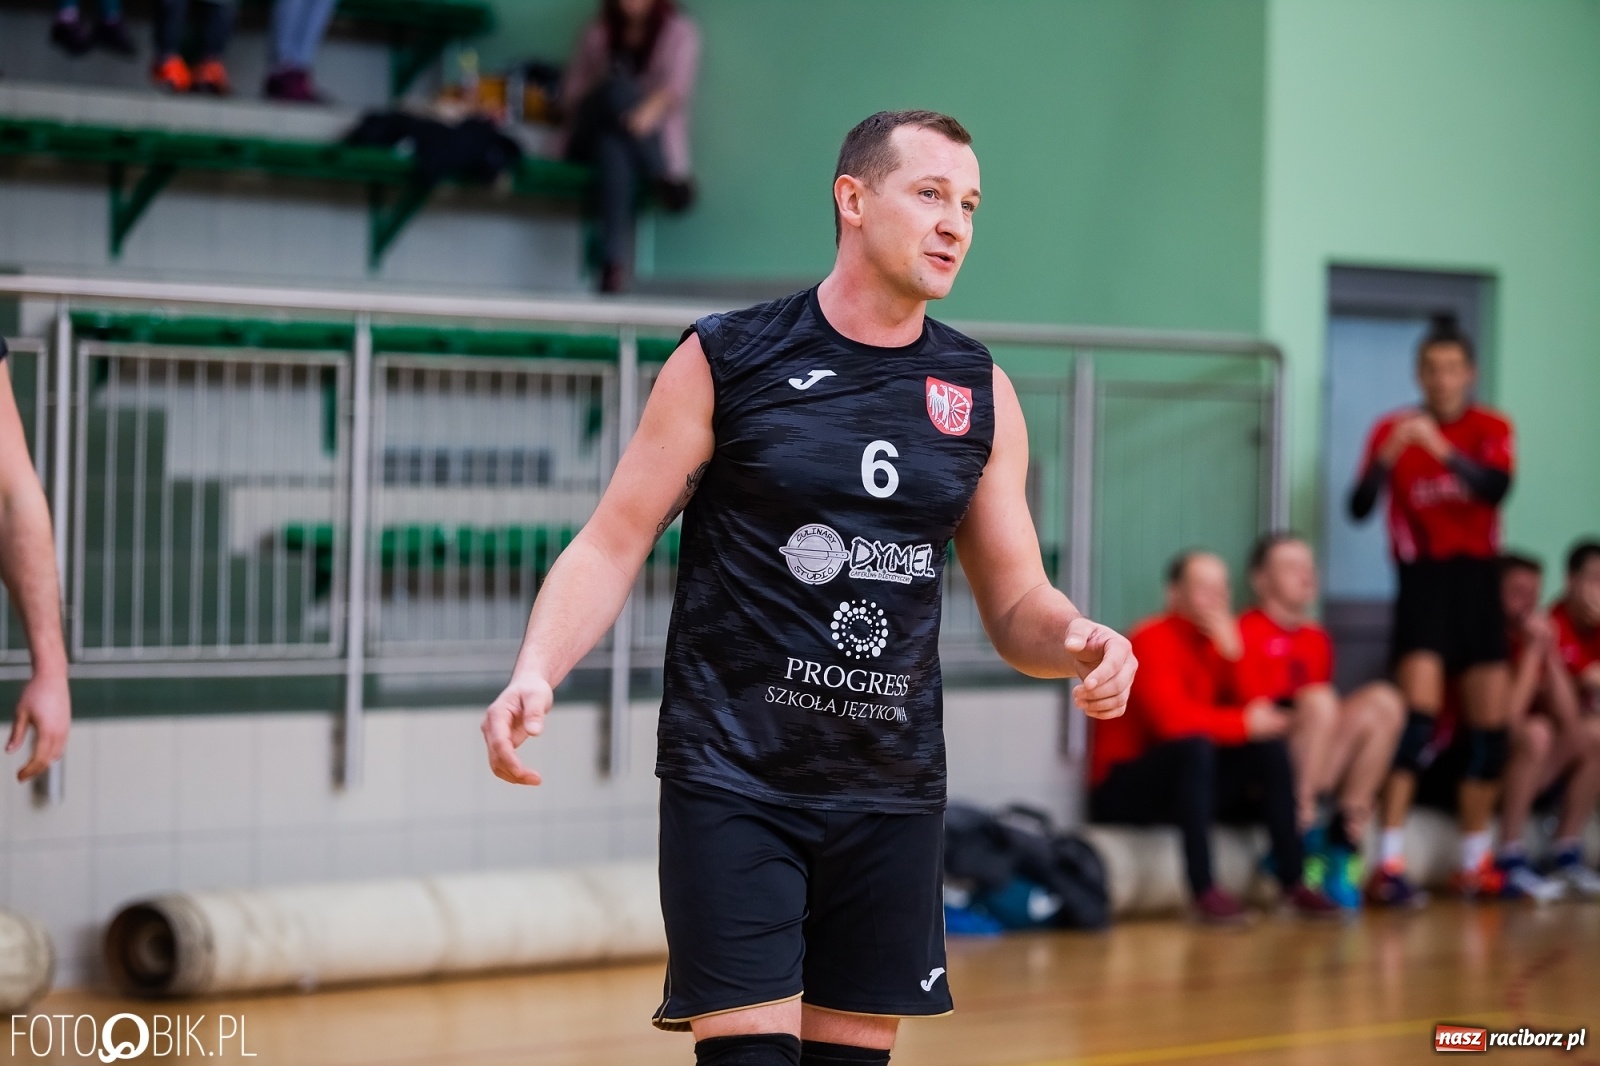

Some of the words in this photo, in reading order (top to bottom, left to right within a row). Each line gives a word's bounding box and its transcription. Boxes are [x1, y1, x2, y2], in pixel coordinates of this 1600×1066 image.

[861, 440, 899, 498] 6
[796, 527, 836, 544] CULINARY
[794, 565, 834, 580] STUDIO
[850, 537, 935, 577] DYMEL
[784, 657, 911, 696] PROGRESS
[765, 686, 837, 713] SZKOŁA
[838, 701, 908, 722] JĘZYKOWA
